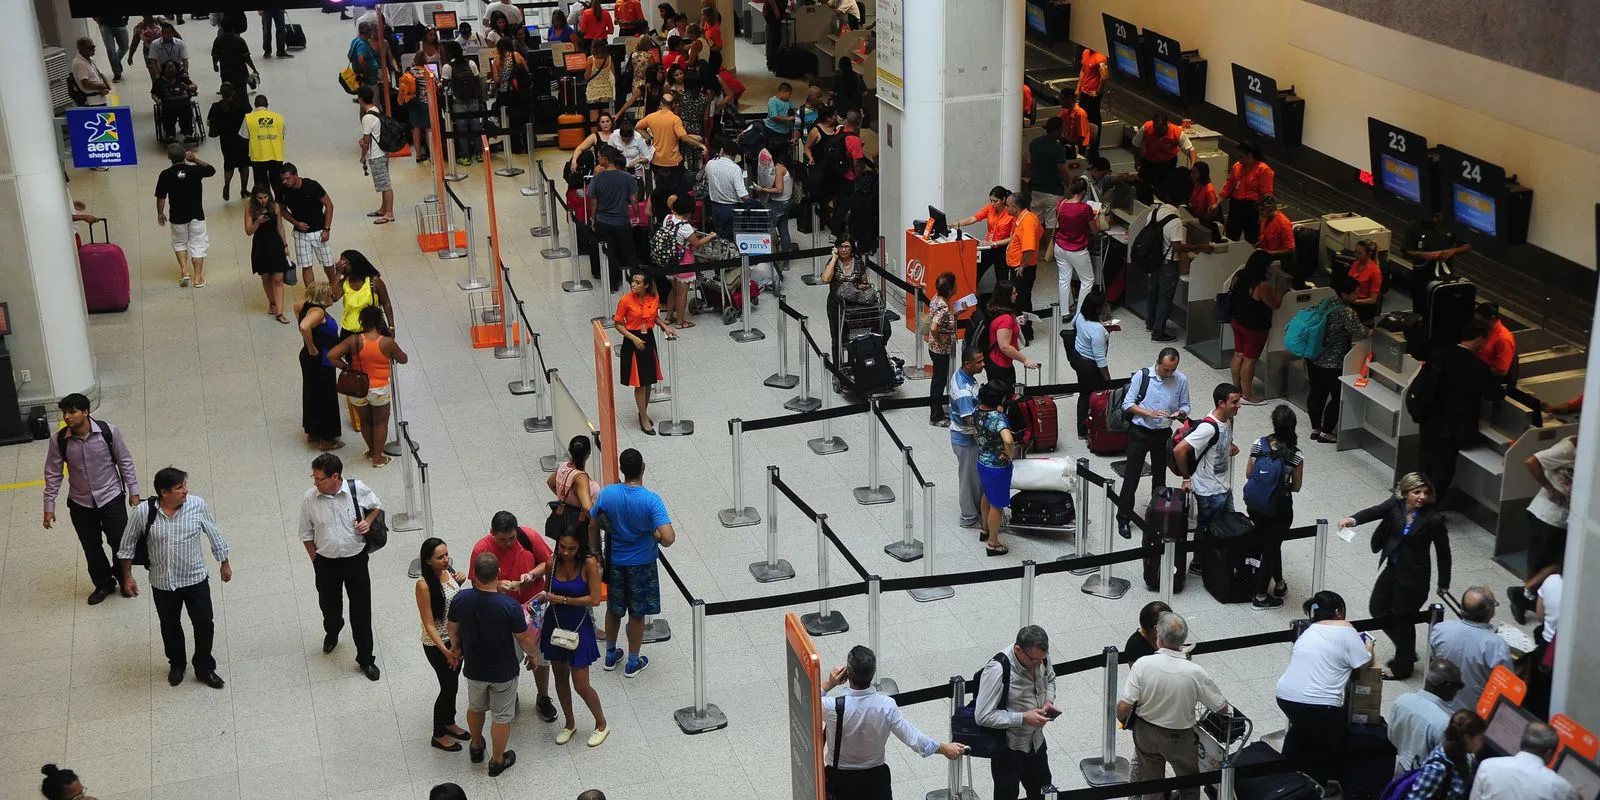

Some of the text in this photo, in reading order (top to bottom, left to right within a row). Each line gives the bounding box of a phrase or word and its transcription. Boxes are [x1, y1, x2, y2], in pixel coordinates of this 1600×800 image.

[1115, 23, 1127, 39] 20
[1156, 39, 1169, 56] 21
[1247, 75, 1262, 94] 22
[87, 142, 120, 152] aero
[1388, 131, 1406, 153] 23
[88, 151, 121, 159] shopping
[1462, 160, 1482, 183] 24
[906, 258, 927, 287] GOL
